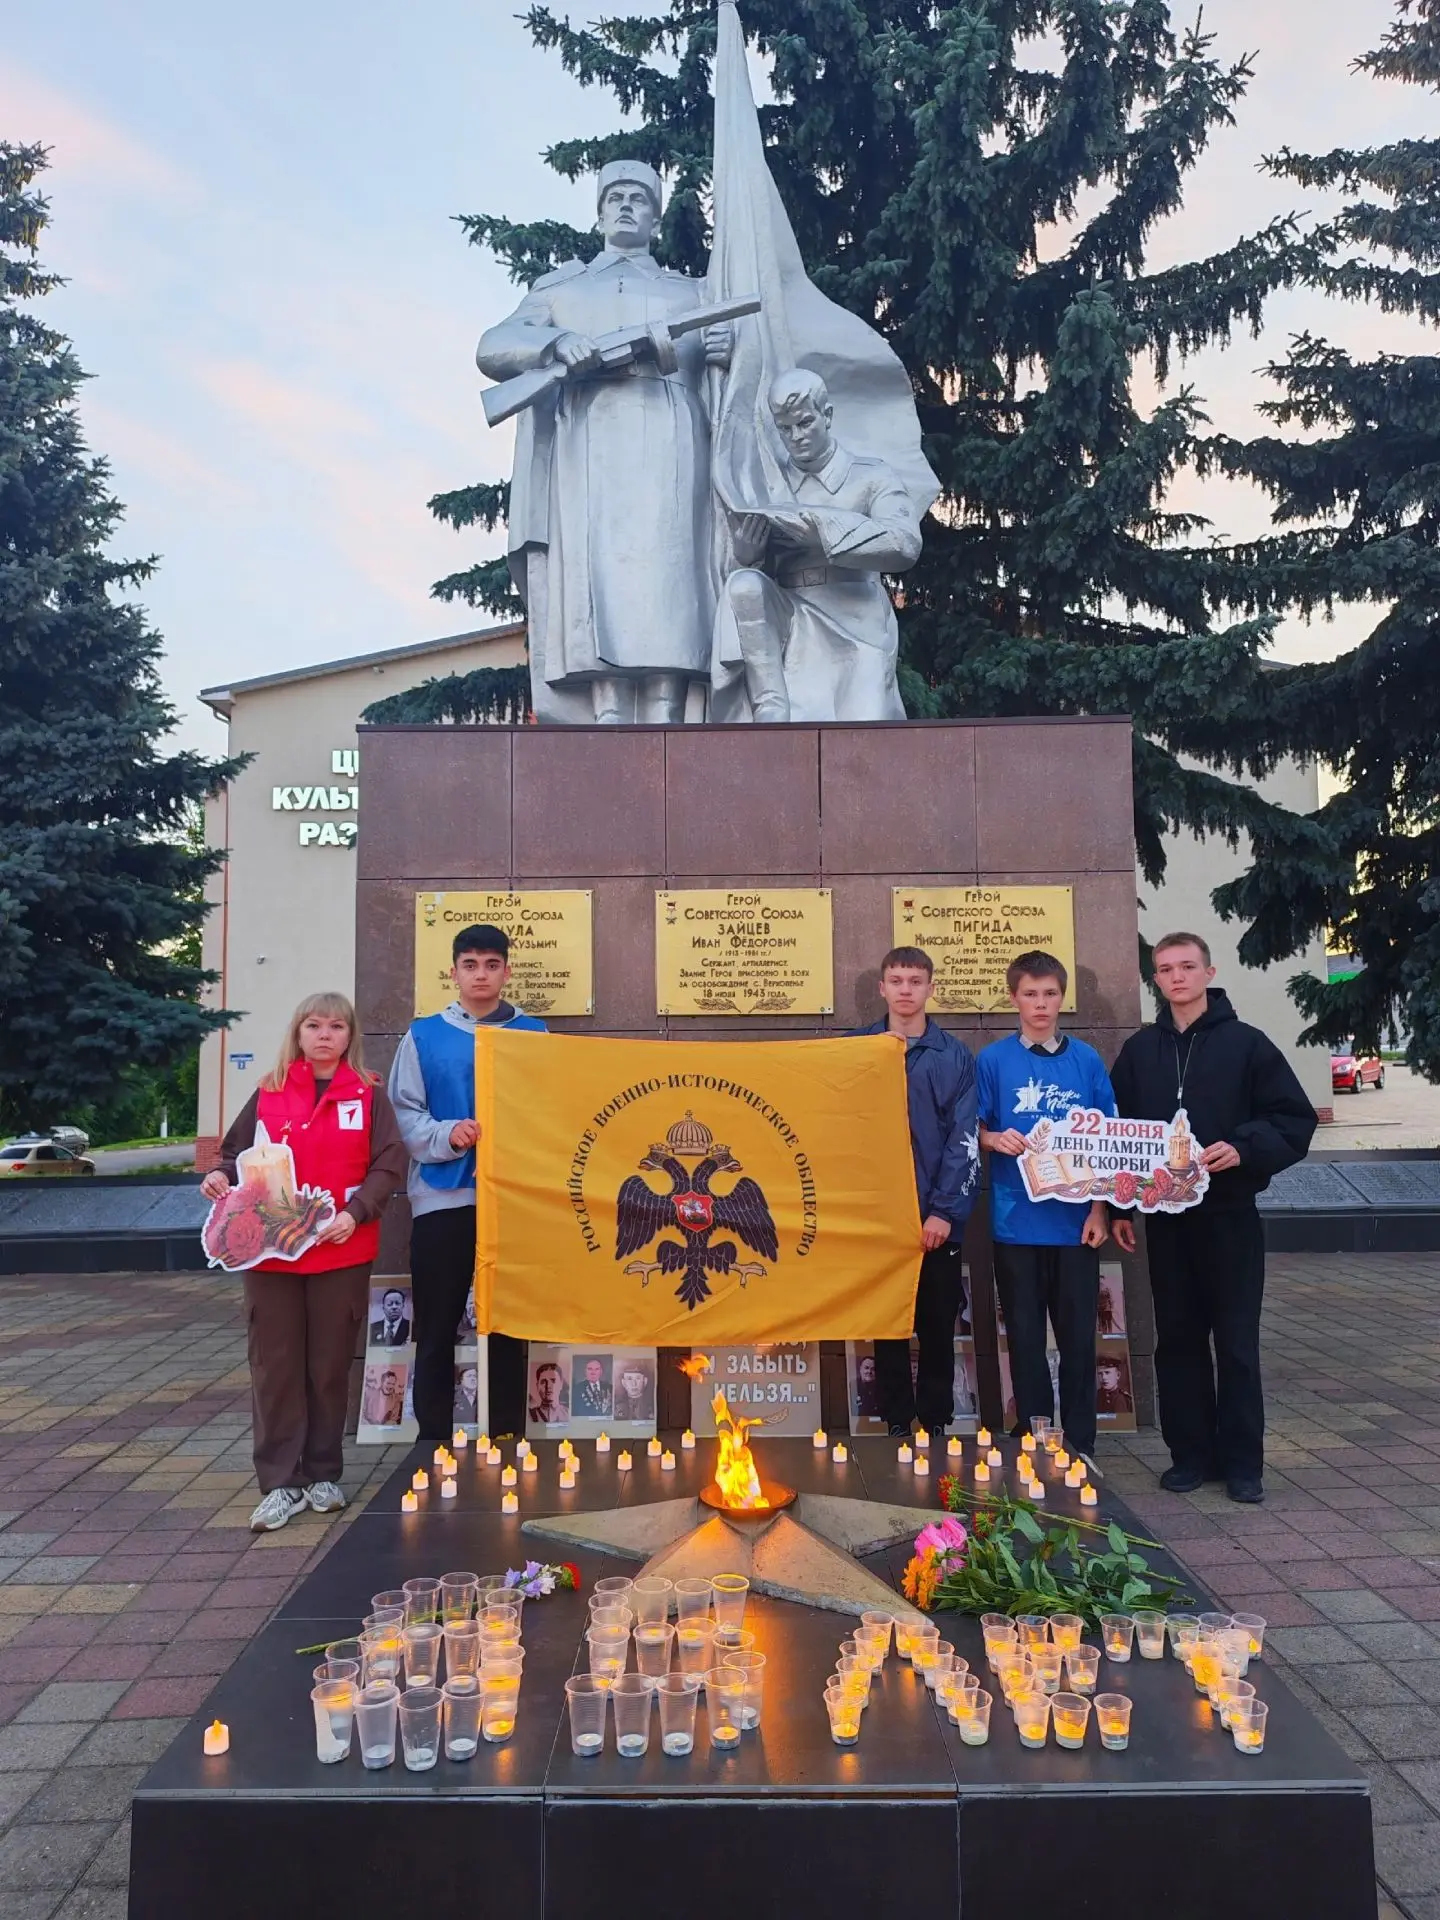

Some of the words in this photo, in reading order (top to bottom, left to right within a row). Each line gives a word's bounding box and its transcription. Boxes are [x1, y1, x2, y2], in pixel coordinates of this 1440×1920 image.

[717, 920, 771, 936] ЗАЙЦЕВ
[953, 920, 1012, 933] ПИГИДА
[1070, 1111, 1100, 1136] 22
[1106, 1121, 1164, 1140] ИЮНЯ
[1052, 1136, 1094, 1152] ДЕНЬ
[1098, 1138, 1165, 1156] ПАМЯТИ
[566, 1128, 600, 1253] РОССИЙСКОЕ
[593, 1074, 799, 1149] ВОЕННО-ИСТОРИЧЕСКОЕ
[794, 1152, 817, 1257] ОБЩЕСТВО
[1072, 1154, 1084, 1168] И
[1088, 1155, 1150, 1172] СКОРБИ
[727, 1353, 807, 1375] ЗАБЫТЬ
